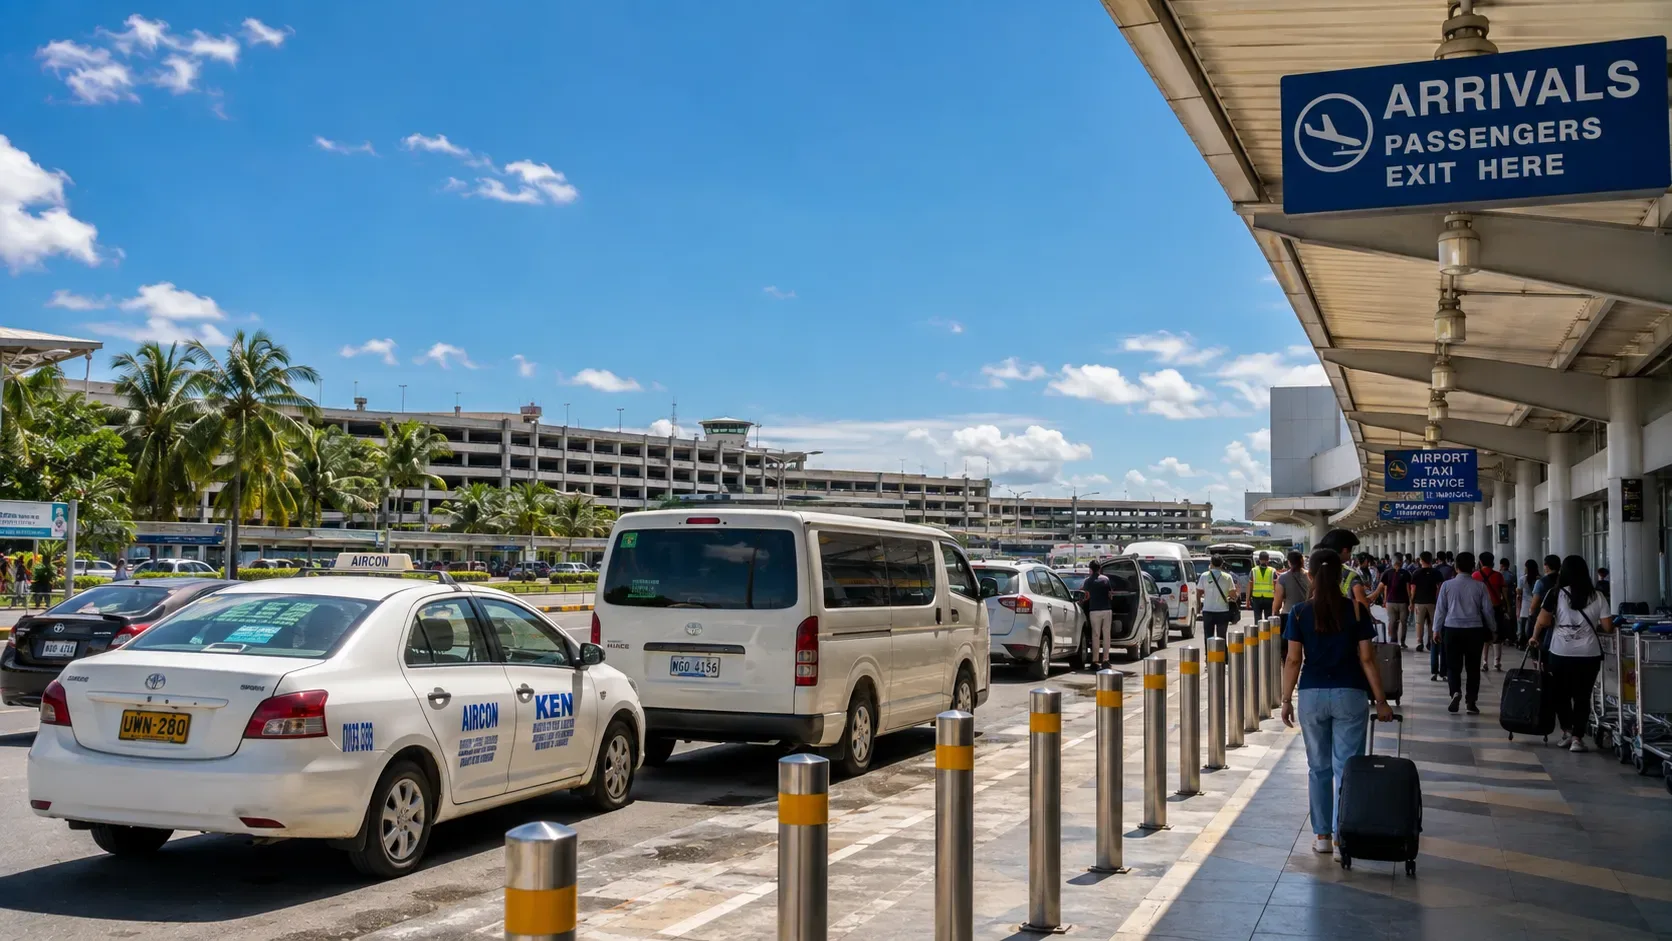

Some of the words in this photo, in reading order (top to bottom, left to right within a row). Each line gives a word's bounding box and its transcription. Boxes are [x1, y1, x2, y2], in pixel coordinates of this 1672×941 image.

[1382, 60, 1641, 120] ARRIVALS
[1385, 116, 1603, 156] PASSENGERS
[1386, 161, 1457, 188] EXIT
[1478, 153, 1565, 181] HERE
[1411, 452, 1469, 464] AIRPORT
[1424, 466, 1453, 476] TAXI
[1412, 478, 1465, 488] SERVICE
[351, 555, 390, 568] AIRCON
[672, 660, 690, 672] NGO
[694, 661, 717, 674] 4156
[535, 692, 573, 720] KEN
[123, 715, 186, 736] UWN-280
[461, 702, 499, 732] AIRCON
